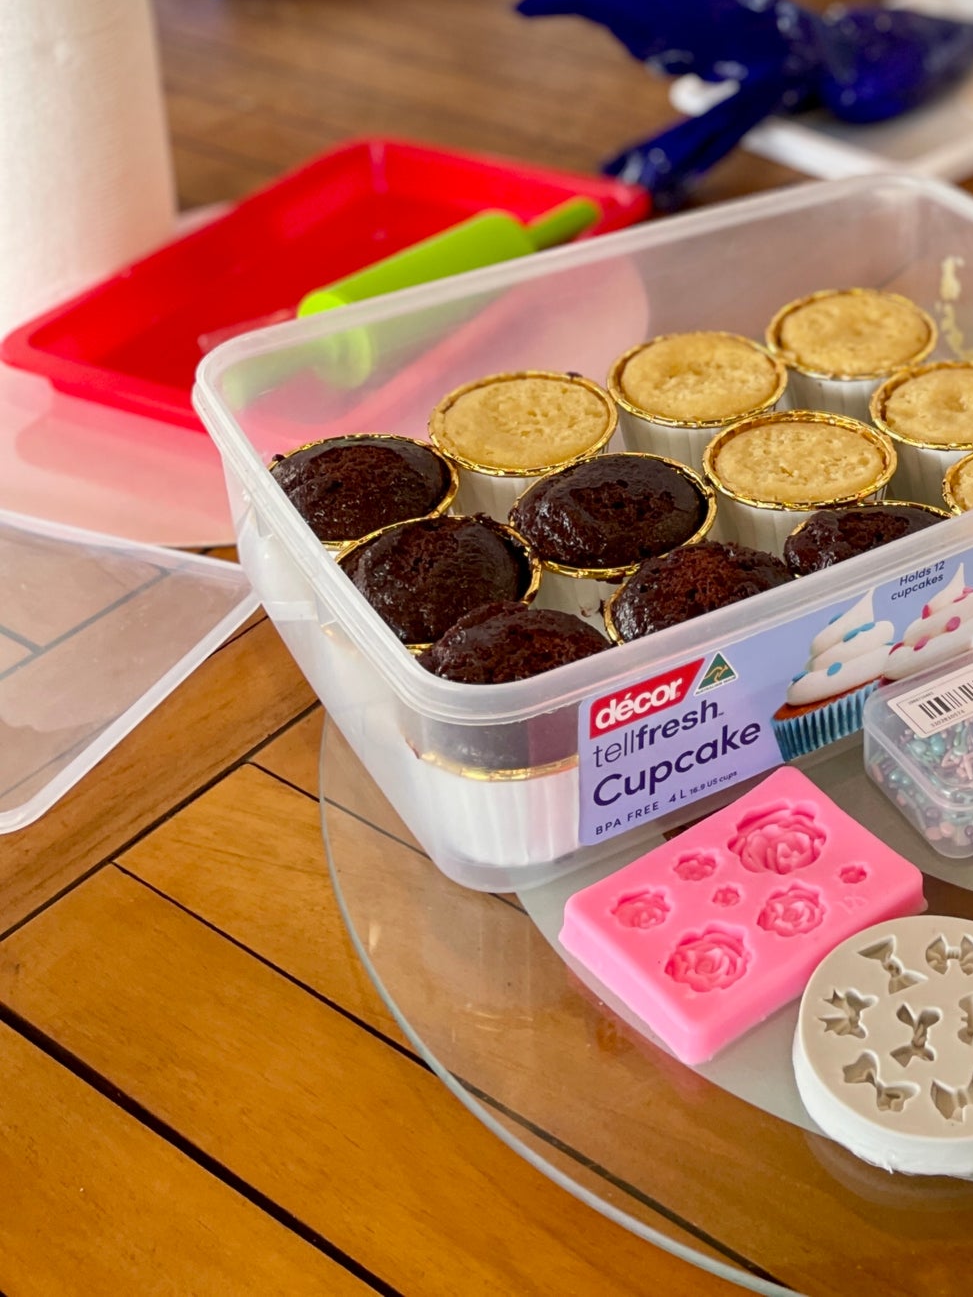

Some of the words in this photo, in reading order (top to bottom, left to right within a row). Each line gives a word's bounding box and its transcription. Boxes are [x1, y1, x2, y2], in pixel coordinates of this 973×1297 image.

[891, 574, 943, 601] cupcakes
[900, 567, 931, 586] Holds
[935, 560, 945, 572] 12
[595, 676, 683, 730] décor
[593, 699, 719, 768] tellfresh
[593, 722, 761, 807] Cupcake
[595, 819, 622, 835] BPA
[627, 801, 659, 822] FREE
[669, 793, 677, 803] 4
[680, 789, 687, 800] L
[690, 783, 706, 795] 16.9
[707, 777, 718, 787] US
[719, 770, 738, 782] cups
